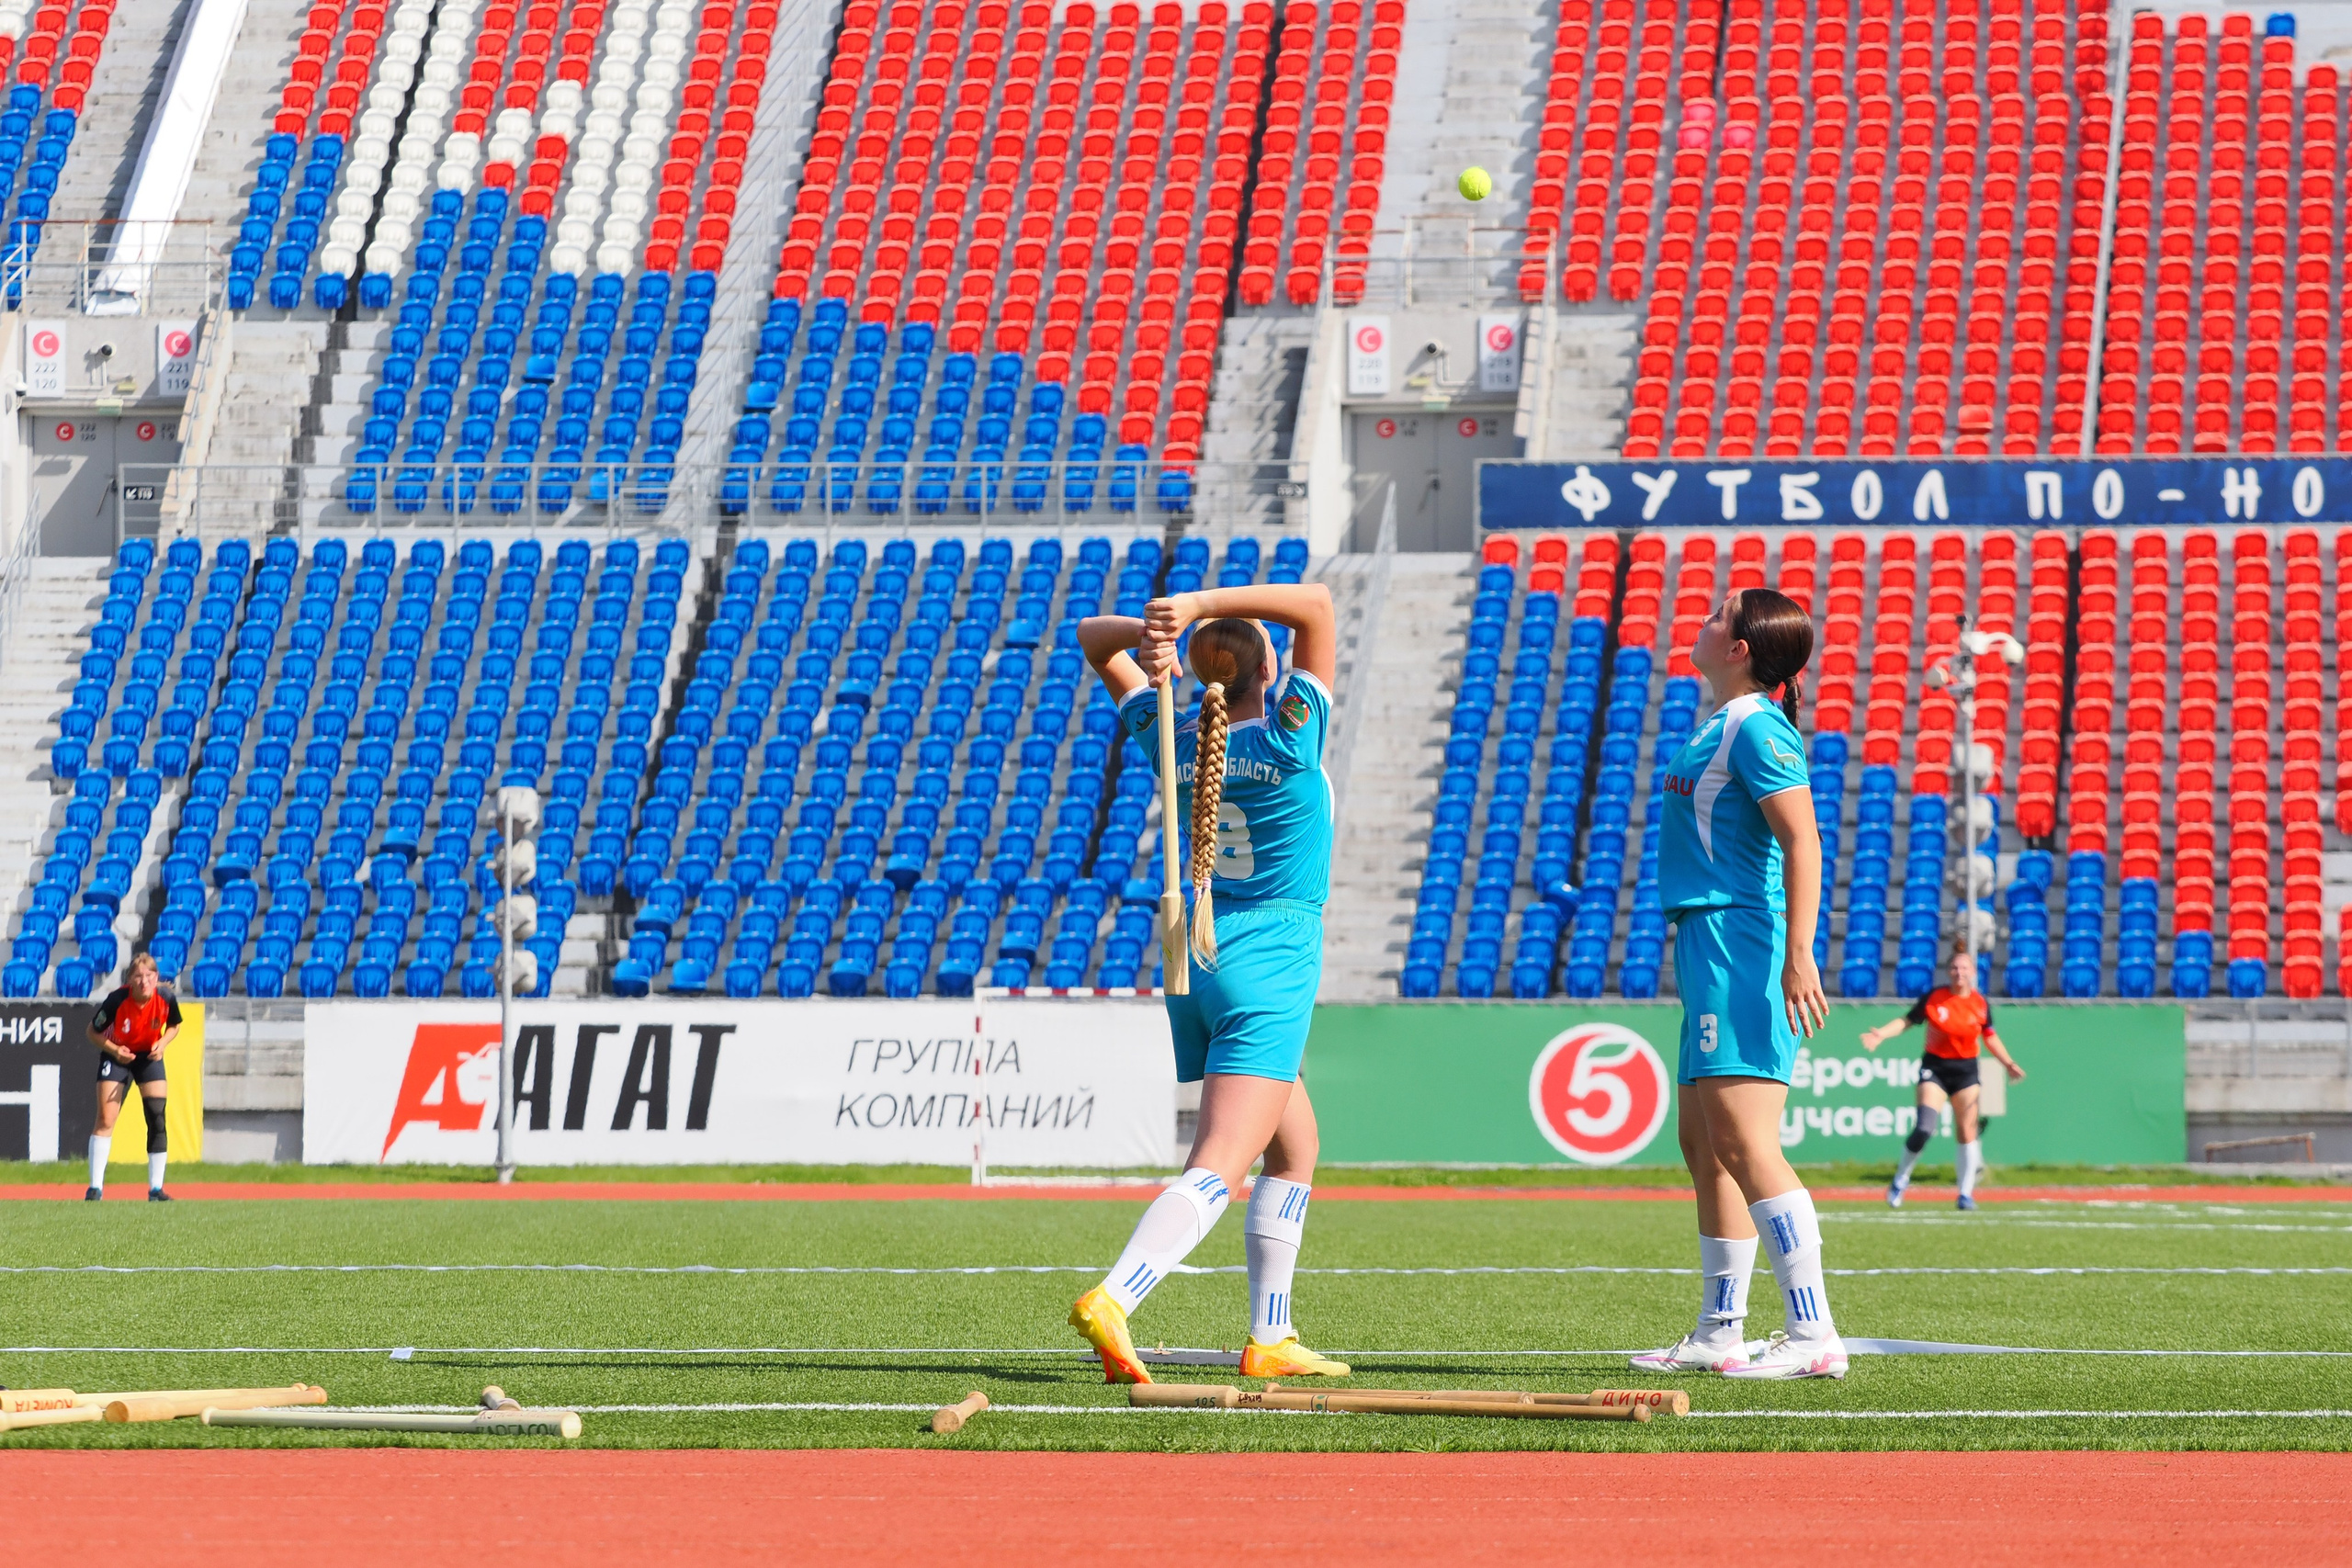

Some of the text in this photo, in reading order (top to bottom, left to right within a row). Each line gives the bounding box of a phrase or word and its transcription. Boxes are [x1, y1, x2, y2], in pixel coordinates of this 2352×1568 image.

[35, 362, 57, 373] 222
[168, 361, 189, 374] 221
[35, 378, 57, 389] 120
[167, 378, 190, 390] 119
[1561, 465, 1950, 522] ФУТБОЛ
[1700, 1013, 1718, 1053] 3
[847, 1039, 1021, 1073] ГРУППА
[101, 1059, 112, 1077] 3
[493, 1024, 738, 1131] АГАТ
[835, 1085, 1095, 1129] КОМПАНИЙ
[1193, 1396, 1216, 1407] 105
[1601, 1391, 1663, 1407] ДИНО
